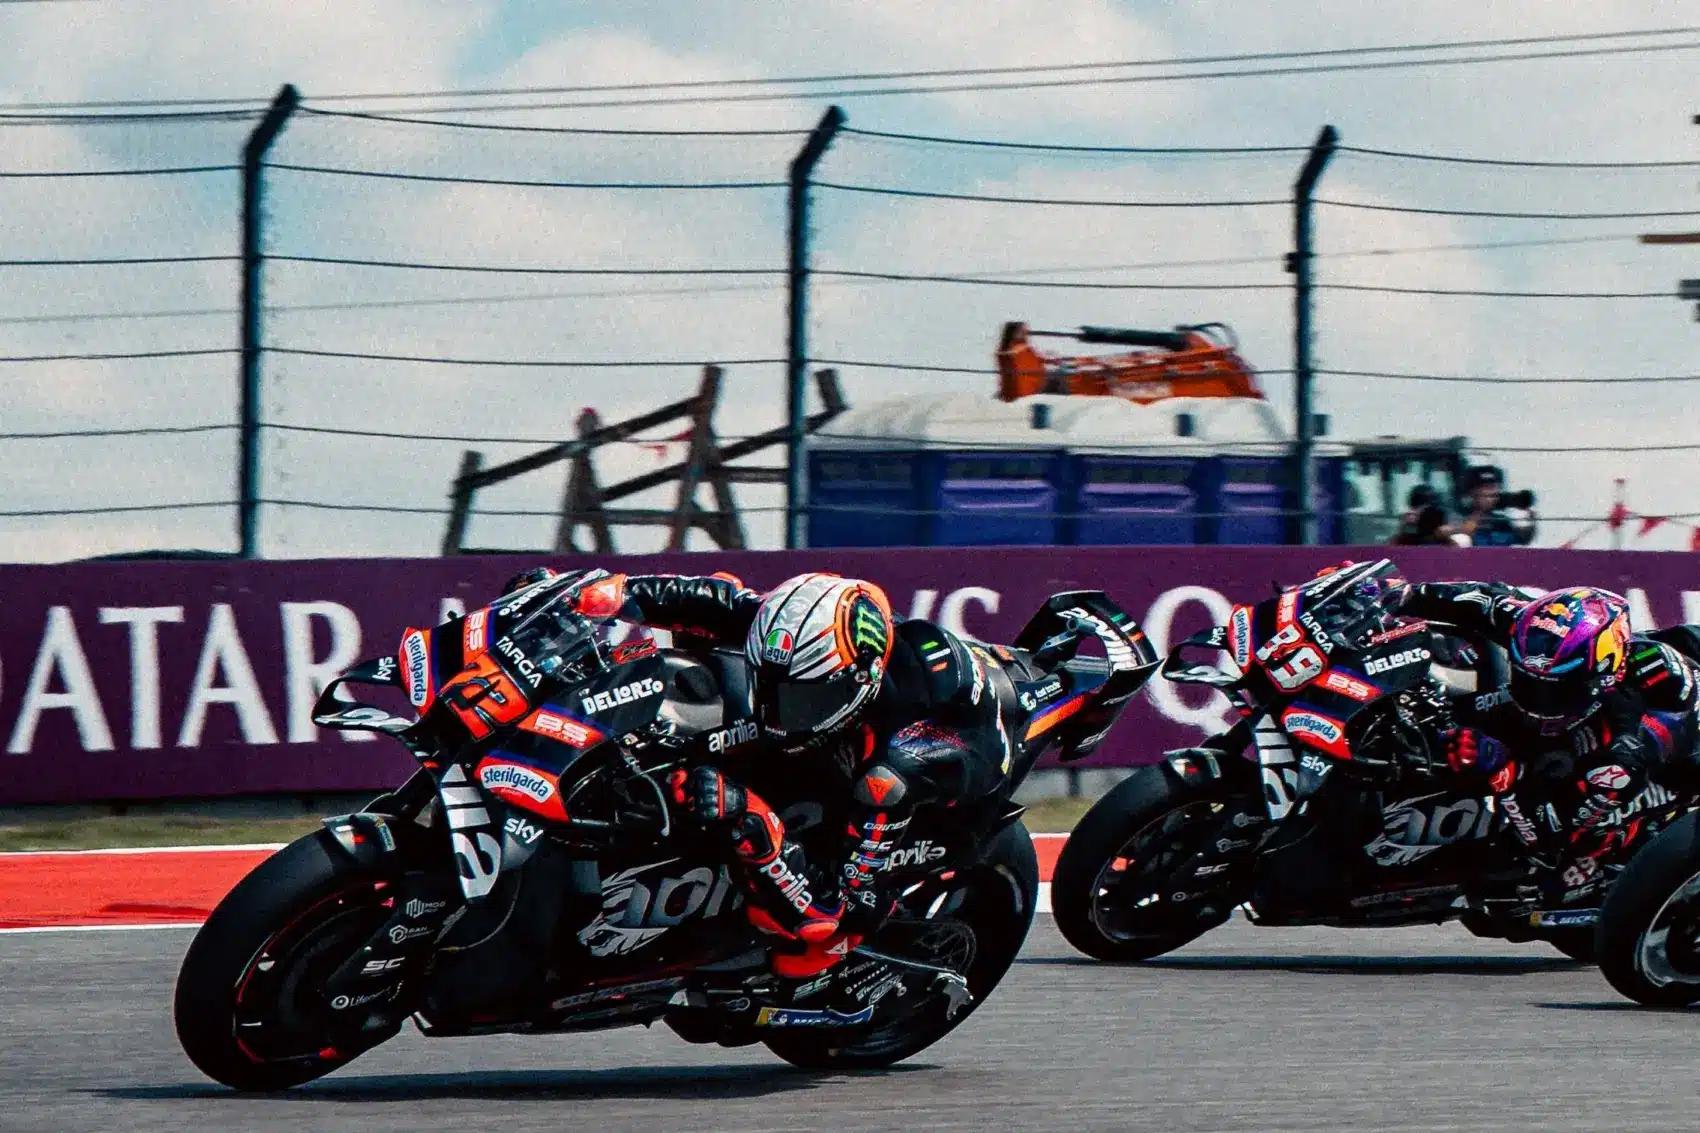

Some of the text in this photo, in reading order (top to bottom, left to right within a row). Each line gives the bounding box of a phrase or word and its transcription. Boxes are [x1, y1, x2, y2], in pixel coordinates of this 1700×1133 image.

[1299, 612, 1332, 654] TARGA
[372, 656, 394, 680] sky
[407, 634, 425, 704] sterilgarda
[496, 635, 542, 688] TARGA
[1255, 624, 1325, 690] 89
[0, 600, 378, 754] ATAR
[536, 713, 588, 743] BS
[708, 721, 759, 754] aprilia
[1286, 716, 1337, 741] sterilgarda
[483, 764, 550, 798] sterilgarda
[1300, 755, 1333, 777] sky
[504, 817, 544, 844] sky
